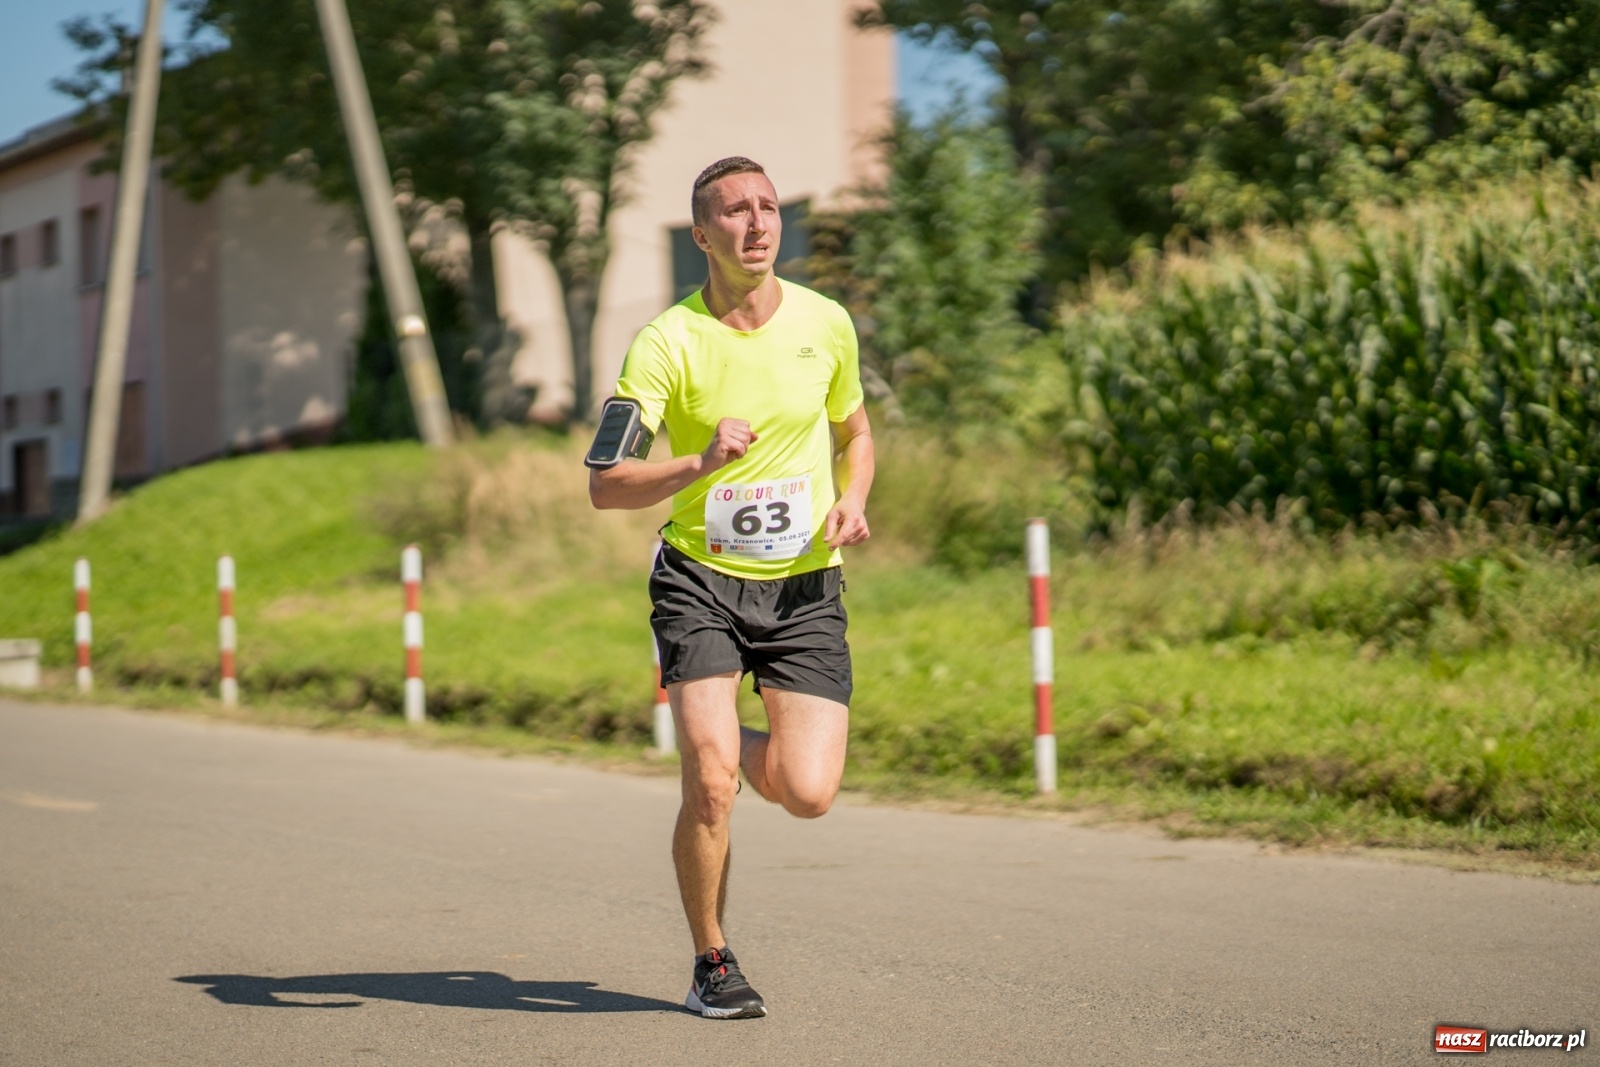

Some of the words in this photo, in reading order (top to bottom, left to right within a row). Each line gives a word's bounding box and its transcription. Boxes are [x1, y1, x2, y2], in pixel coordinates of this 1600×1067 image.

[714, 485, 774, 502] COLOUR
[781, 480, 805, 498] RUN
[731, 501, 792, 537] 63
[710, 537, 731, 545] 10km,
[733, 537, 776, 545] Krzanowice,
[778, 530, 811, 542] 05.09.2021
